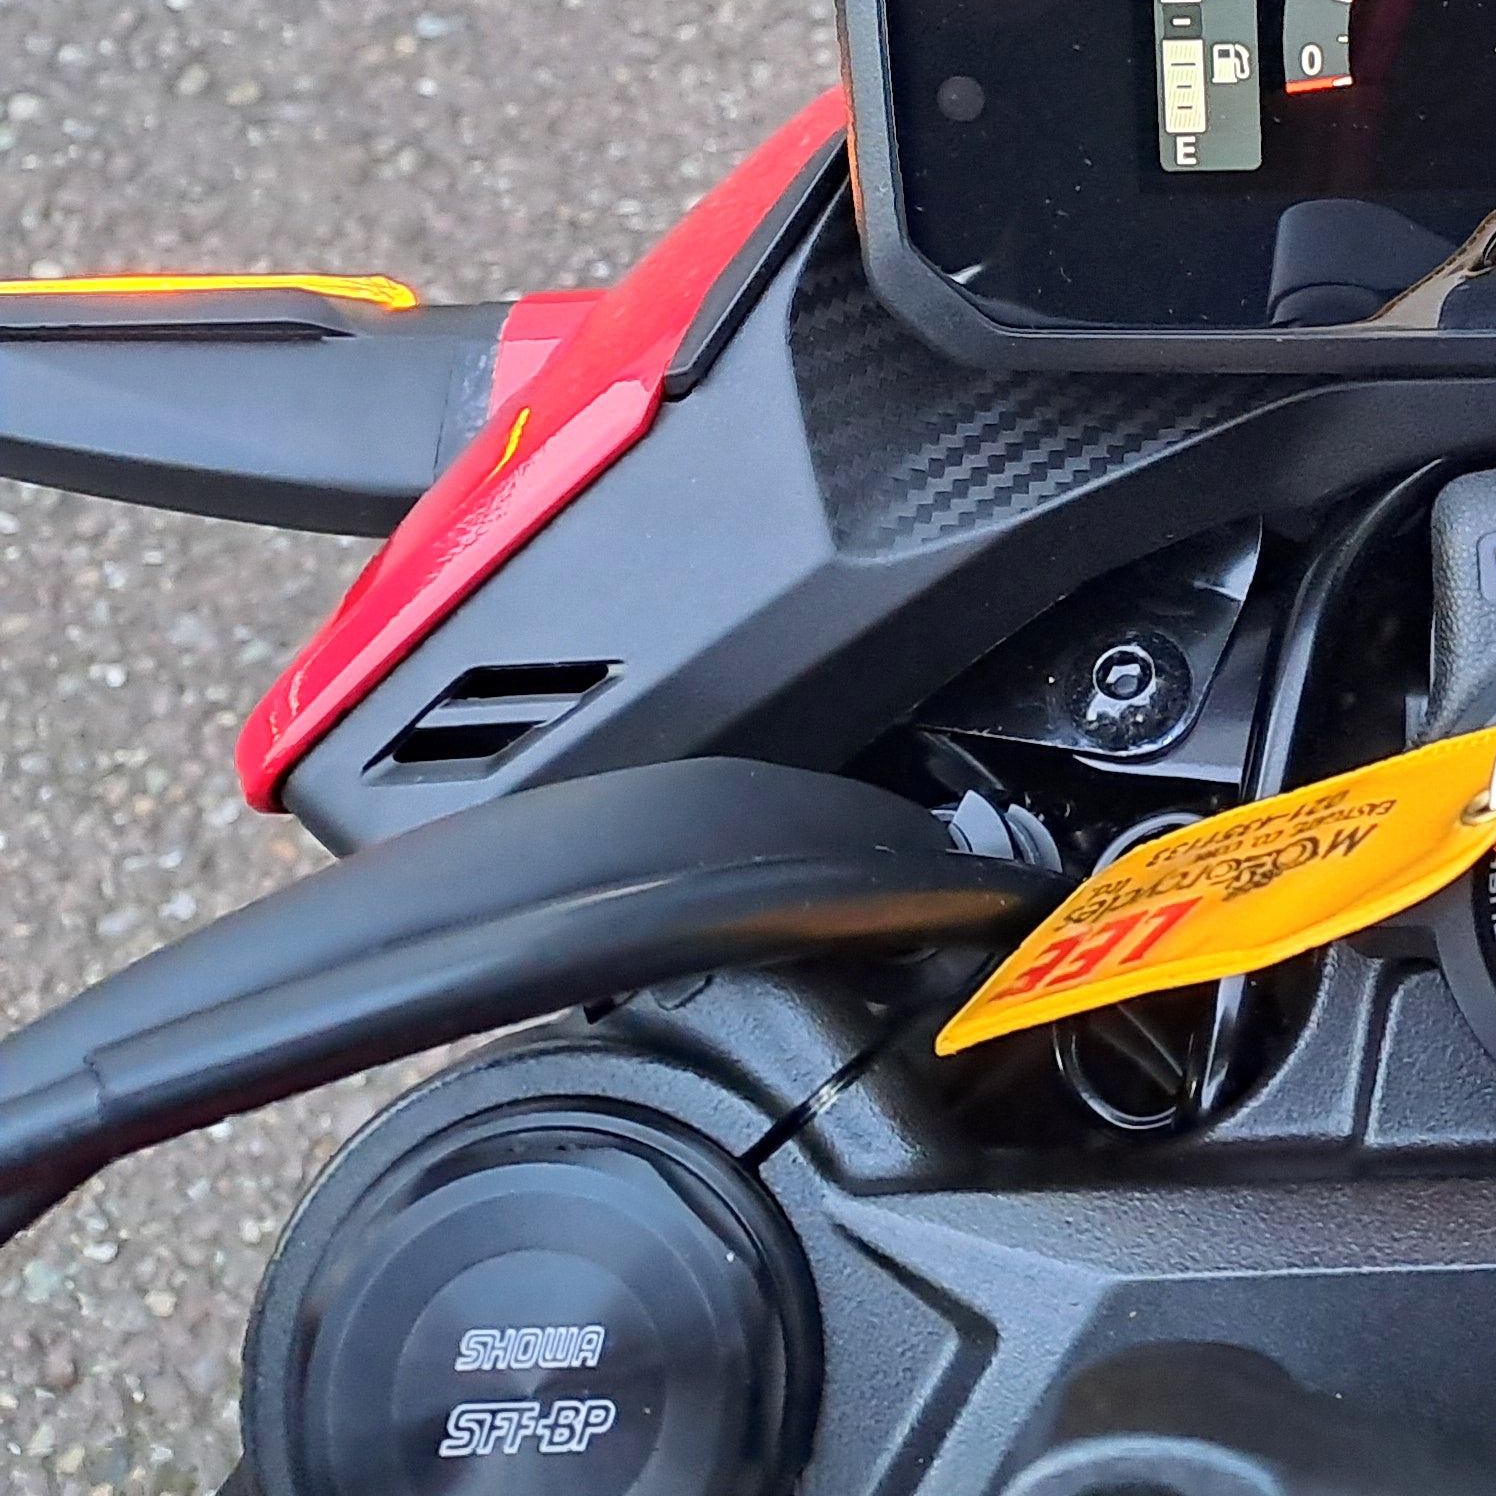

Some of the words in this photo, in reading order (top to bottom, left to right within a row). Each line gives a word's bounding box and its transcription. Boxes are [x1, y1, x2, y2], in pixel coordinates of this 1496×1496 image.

[1301, 44, 1323, 76] 0
[1176, 135, 1198, 166] E
[987, 895, 1204, 1004] LEE
[454, 1325, 606, 1372] SHOWA
[438, 1399, 616, 1457] SFF-BP
